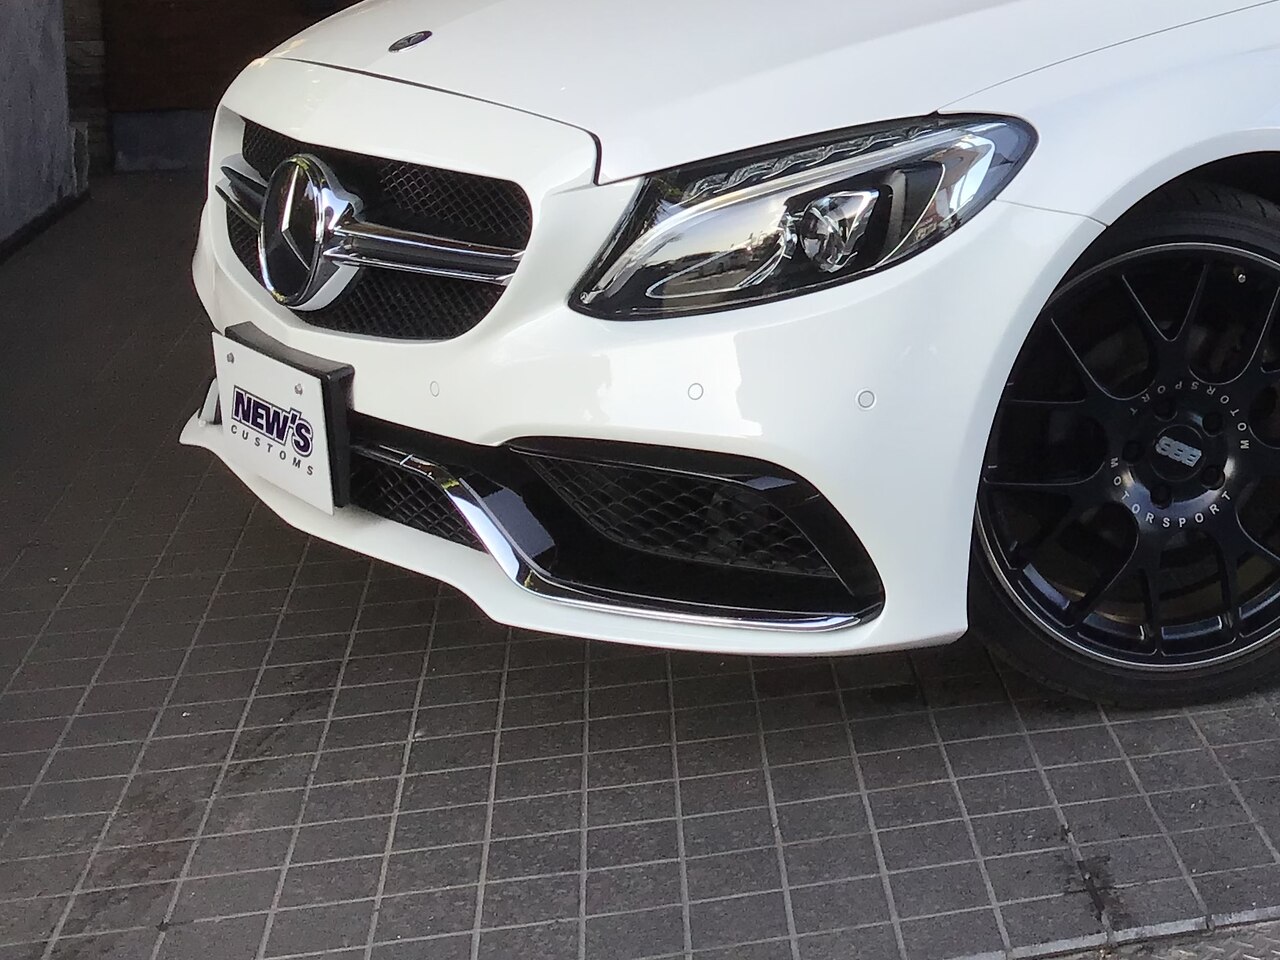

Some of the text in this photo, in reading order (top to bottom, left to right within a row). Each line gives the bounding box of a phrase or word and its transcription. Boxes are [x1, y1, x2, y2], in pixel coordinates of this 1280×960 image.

[233, 387, 313, 456] NEW'S
[1130, 381, 1250, 449] MOTORSPORT
[231, 424, 314, 476] CUSTOMS
[1155, 436, 1202, 467] BBS
[1110, 457, 1231, 527] MOTORSPORT
